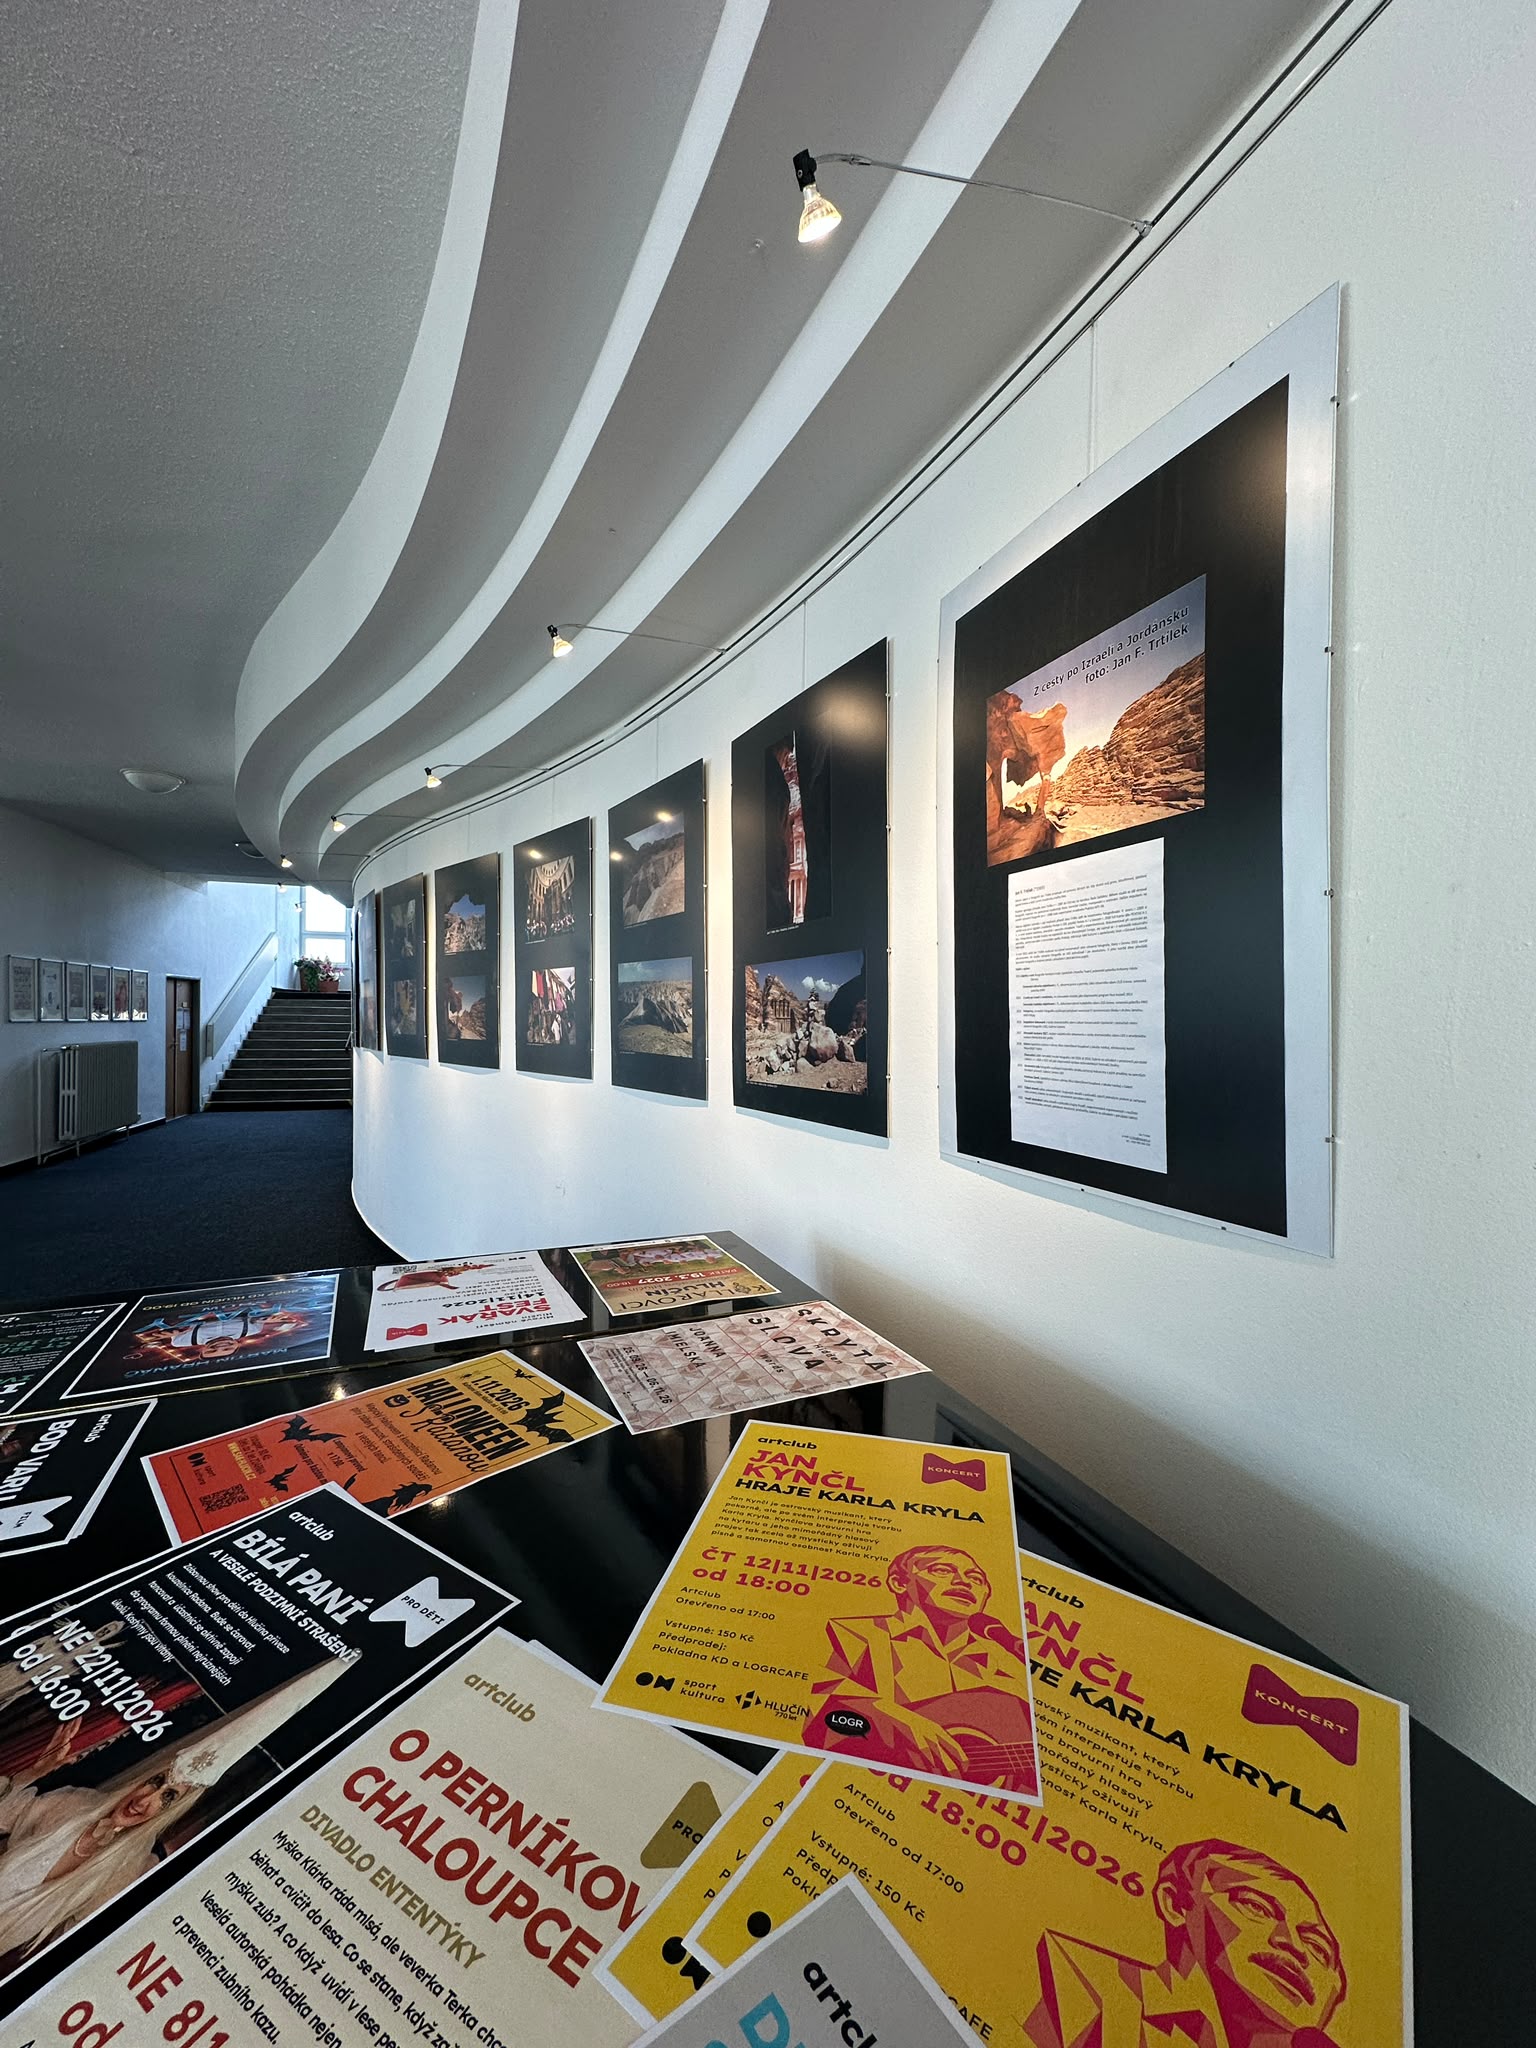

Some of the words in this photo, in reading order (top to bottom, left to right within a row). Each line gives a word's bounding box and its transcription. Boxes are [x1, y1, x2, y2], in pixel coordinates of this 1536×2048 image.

[1033, 685, 1040, 697] Z
[1040, 673, 1065, 694] cesty
[1066, 665, 1079, 682] po
[1080, 643, 1114, 673] Izraeli
[1116, 640, 1123, 653] a
[1084, 664, 1110, 684] foto:
[1112, 653, 1132, 671] Jan
[1134, 646, 1146, 659] F.
[638, 1276, 673, 1284] 2027
[645, 1281, 725, 1296] HLUČÍN
[438, 1302, 551, 1325] SVAŘÁK
[479, 1298, 547, 1312] FEST
[665, 1331, 706, 1368] IMIELSKA
[689, 1328, 726, 1358] JOANNA
[748, 1317, 825, 1370] SLOVA
[798, 1309, 893, 1371] SKRYTÁ
[814, 1344, 843, 1364] Hidden
[759, 1354, 784, 1373] Words
[471, 1376, 530, 1411] 1.11.2026
[30, 1418, 78, 1454] BOD
[83, 1413, 113, 1443] artclub
[406, 1378, 531, 1461] HALLOWEEN
[749, 1450, 817, 1470] JAN
[758, 1437, 817, 1449] artclub
[742, 1458, 865, 1492] KYNČL
[928, 1466, 980, 1477] KONCERT
[735, 1478, 812, 1498] HRAJE
[818, 1490, 896, 1510] KARLA
[903, 1502, 985, 1523] KRYLA
[289, 1512, 334, 1541] artclub
[232, 1529, 310, 1579] BÍLÁ
[286, 1568, 374, 1625] PANÍ
[692, 1568, 727, 1582] od
[736, 1573, 810, 1596] 18:00
[702, 1546, 736, 1563] ČT
[744, 1556, 882, 1588] 12|11|2026
[130, 1590, 140, 1598] do
[133, 1596, 163, 1620] programu
[165, 1571, 193, 1596] kouzelnice
[210, 1611, 227, 1626] Bude
[223, 1624, 234, 1632] se
[205, 1583, 222, 1596] show
[216, 1594, 231, 1604] pro
[238, 1611, 249, 1619] do
[209, 1549, 224, 1558] A
[218, 1553, 258, 1582] VESELÉ
[247, 1578, 308, 1621] PODZIMNÍ
[297, 1617, 361, 1665] STRAŠENÍ
[401, 1595, 421, 1609] PRO
[419, 1607, 445, 1625] DĚTI
[676, 1597, 727, 1611] Otevřeno
[747, 1610, 775, 1620] 17:00
[680, 1586, 721, 1599] Artclub
[52, 1620, 96, 1651] NE
[158, 1617, 181, 1638] formou
[666, 1619, 714, 1635] Vstupné:
[718, 1629, 737, 1638] 150
[739, 1633, 754, 1642] Kč
[1024, 1600, 1081, 1643] AN
[13, 1644, 55, 1671] od
[658, 1631, 727, 1651] Předprodej:
[652, 1644, 707, 1661] Pokladna
[711, 1655, 729, 1664] KD
[743, 1661, 809, 1681] LOGRCAFE
[17, 1664, 90, 1721] 16:00
[55, 1644, 173, 1742] 22|11|2026
[464, 1674, 536, 1722] artclub
[680, 1687, 725, 1703] kultura
[684, 1680, 717, 1691] sport
[764, 1700, 811, 1719] HLUČÍN
[831, 1714, 864, 1728] LOGR
[1255, 1690, 1348, 1734] KONCERT
[1057, 1737, 1115, 1773] bravurní
[1118, 1769, 1143, 1788] hra
[1061, 1724, 1143, 1772] interpretuje
[1146, 1769, 1194, 1800] tvorbu
[1069, 1681, 1190, 1754] KARLA
[1203, 1744, 1348, 1833] KRYLA
[1074, 1718, 1138, 1756] muzikant,
[1142, 1751, 1181, 1777] který
[844, 1784, 895, 1821] Artclub
[389, 1729, 430, 1762] O
[419, 1750, 647, 1933] PERNÍKOV
[672, 1819, 704, 1845] PRO
[920, 1789, 1027, 1866] 18:00
[1079, 1796, 1118, 1825] Karla
[1122, 1821, 1167, 1854] Kryla.
[834, 1799, 898, 1847] Otevřeno
[902, 1847, 922, 1864] od
[924, 1861, 964, 1893] 17:00
[300, 1805, 375, 1872] DIVADLO
[369, 1865, 486, 1969] ENTENTÝKY
[343, 1766, 603, 1989] CHALOUPCE
[811, 1830, 872, 1883] Vstupné:
[875, 1880, 901, 1903] 150
[904, 1901, 925, 1923] Kč
[172, 1915, 185, 1927] a
[272, 1830, 304, 1862] Myška
[299, 1856, 334, 1891] Klárka
[329, 1887, 357, 1913] ráda
[353, 1909, 383, 1941] mlsá,
[380, 1935, 400, 1955] ale
[399, 1950, 444, 1998] veverka
[443, 1989, 479, 2031] Terka
[175, 1922, 224, 1970] prevenci
[249, 1849, 280, 1880] běhat
[274, 1877, 286, 1888] a
[282, 1885, 312, 1912] cvičit
[306, 1908, 322, 1925] do
[319, 1919, 344, 1949] lesa.
[343, 1943, 359, 1962] Co
[356, 1959, 372, 1976] se
[369, 1972, 403, 2013] stane,
[402, 2001, 438, 2039] když
[116, 1941, 184, 2014] NE
[200, 1890, 233, 1927] Veselá
[225, 1923, 272, 1971] autorská
[261, 1966, 313, 2019] pohádka
[308, 2014, 342, 2048] nejen
[214, 1965, 255, 2012] zubního
[803, 1962, 878, 2048] artcl
[250, 2004, 280, 2045] kazu.
